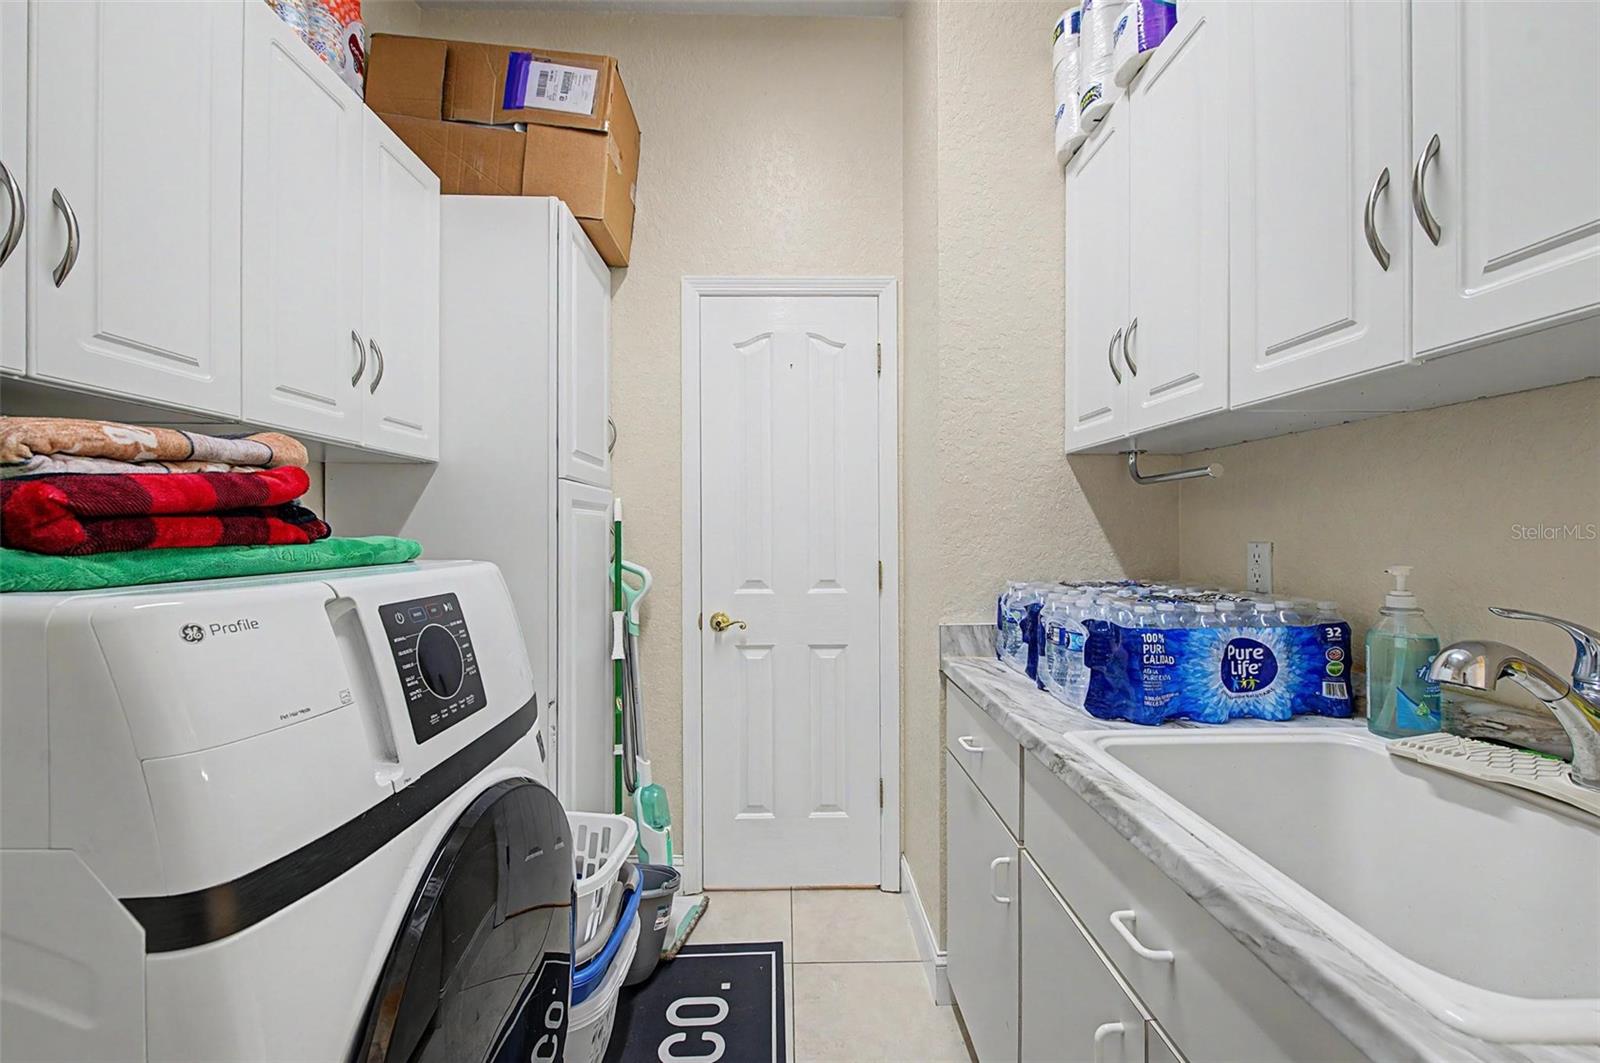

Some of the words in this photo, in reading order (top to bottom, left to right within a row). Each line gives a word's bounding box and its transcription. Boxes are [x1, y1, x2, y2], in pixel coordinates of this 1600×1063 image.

[209, 618, 260, 636] Profile
[1325, 627, 1342, 638] 32
[1141, 633, 1165, 643] 100%
[1227, 644, 1264, 660] Pure
[1231, 660, 1259, 678] Life
[657, 982, 731, 1063] CO.
